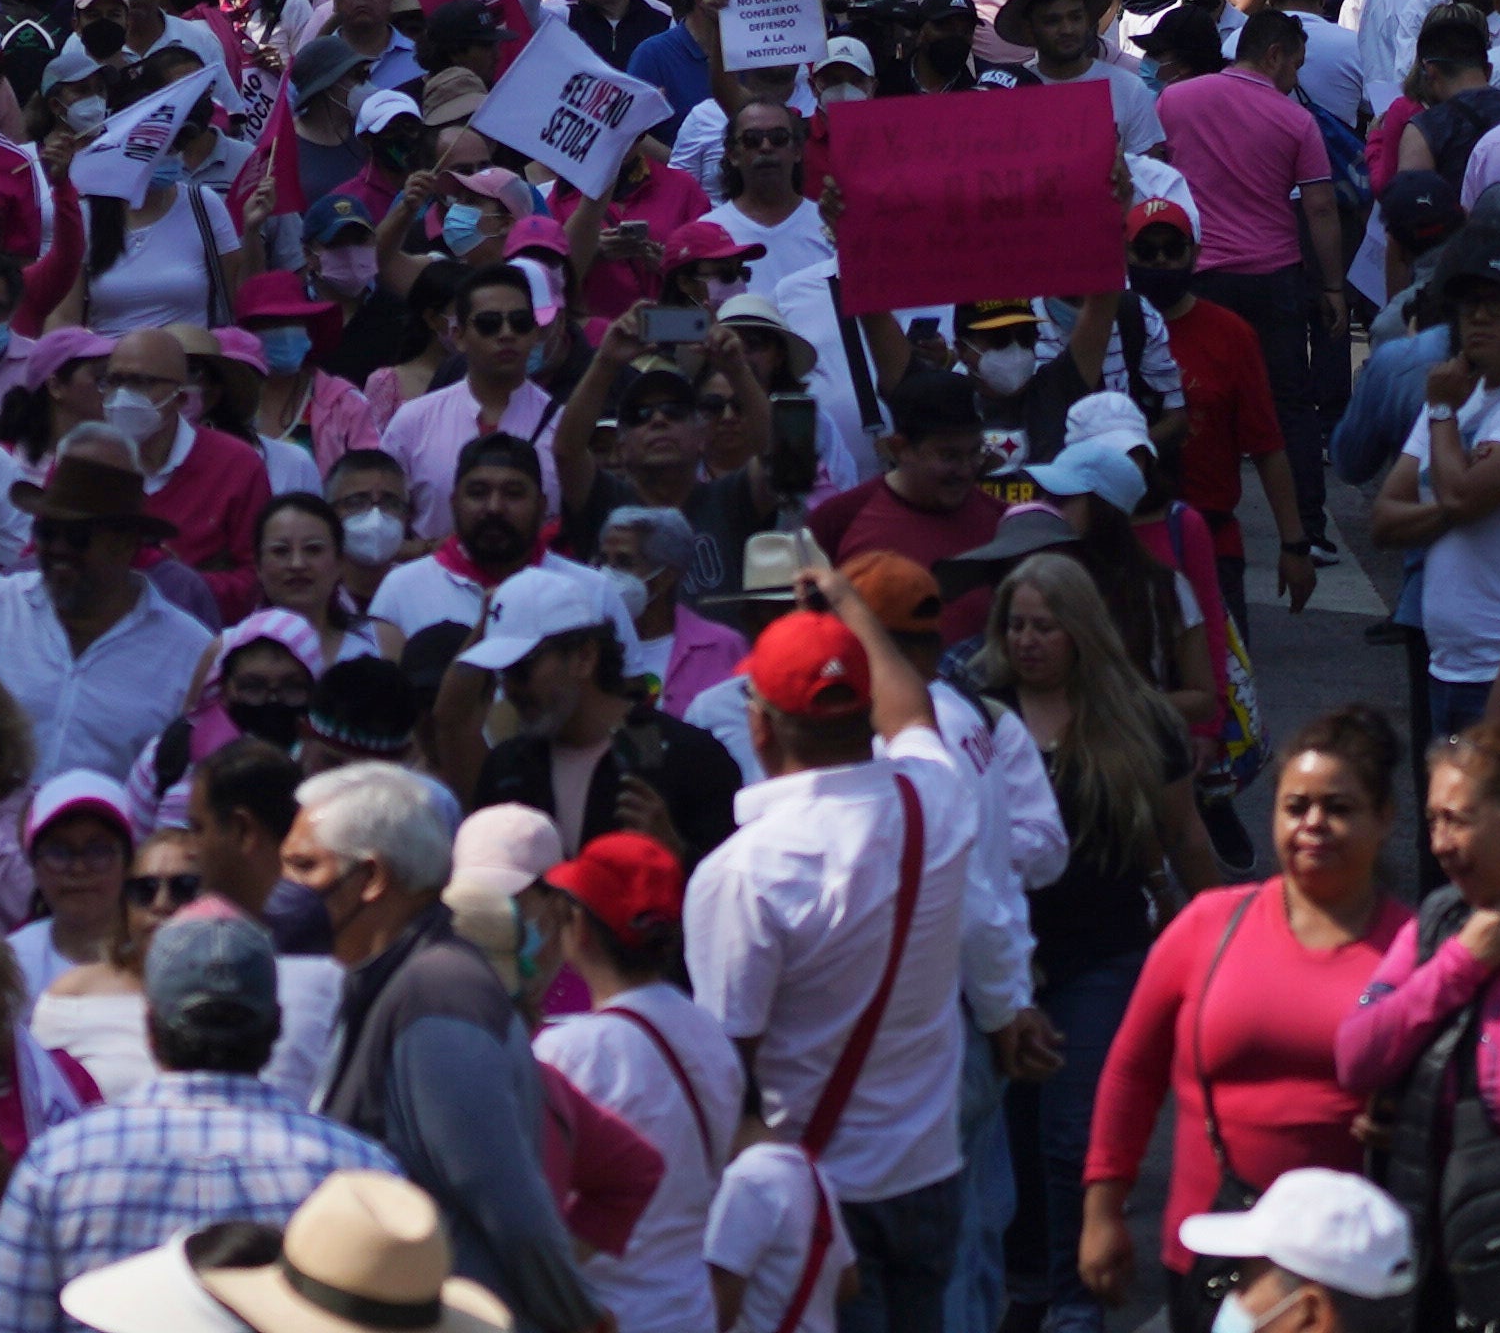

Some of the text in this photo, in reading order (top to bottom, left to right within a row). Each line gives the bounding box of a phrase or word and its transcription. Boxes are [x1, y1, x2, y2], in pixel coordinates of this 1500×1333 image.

[748, 19, 796, 33] DEFIENDO
[763, 33, 785, 44] A LA
[746, 44, 807, 60] INSTITUCIÓN
[558, 71, 636, 131] #ELINENO
[540, 104, 602, 164] SETOCA
